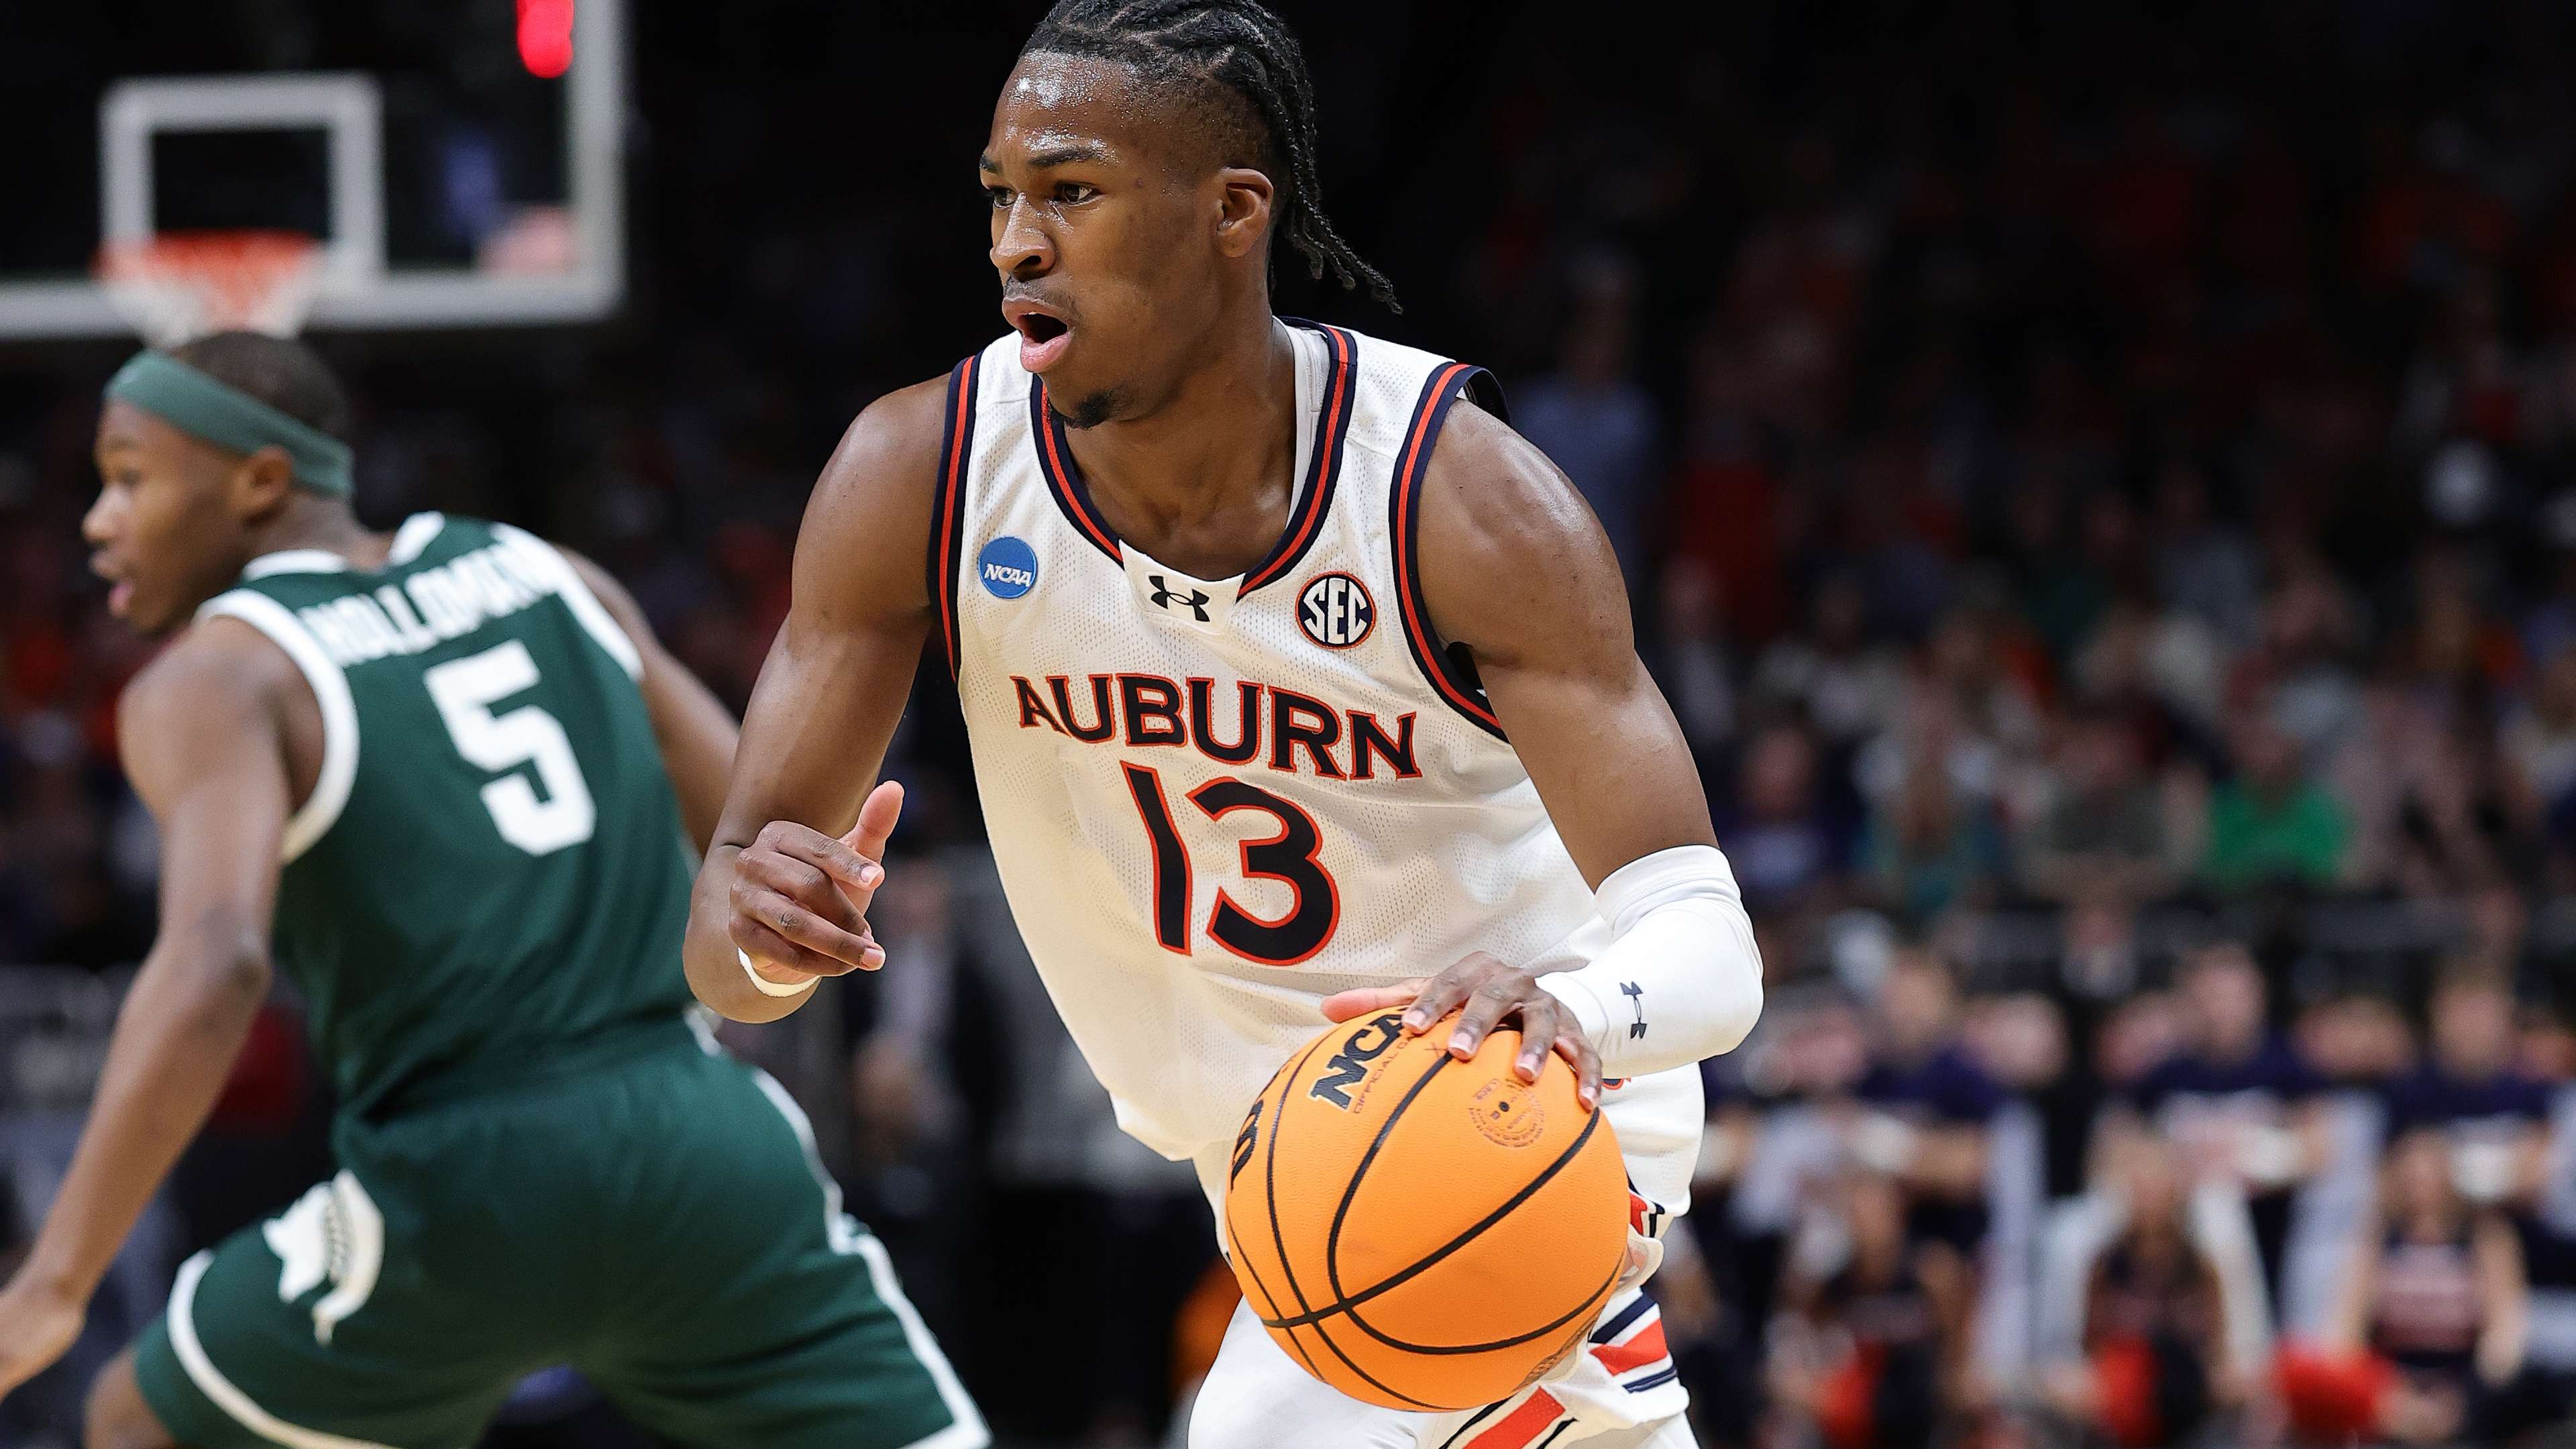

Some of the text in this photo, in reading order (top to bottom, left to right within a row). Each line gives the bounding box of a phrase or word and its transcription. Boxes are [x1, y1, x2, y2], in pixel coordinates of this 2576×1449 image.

[297, 538, 558, 667] HOLLOM
[984, 562, 1032, 588] NCAA
[1303, 577, 1368, 645] SEC
[423, 638, 596, 857] 5
[1009, 672, 1423, 782] AUBURN
[1120, 759, 1341, 966] 13
[1308, 1006, 1409, 1111] NCA
